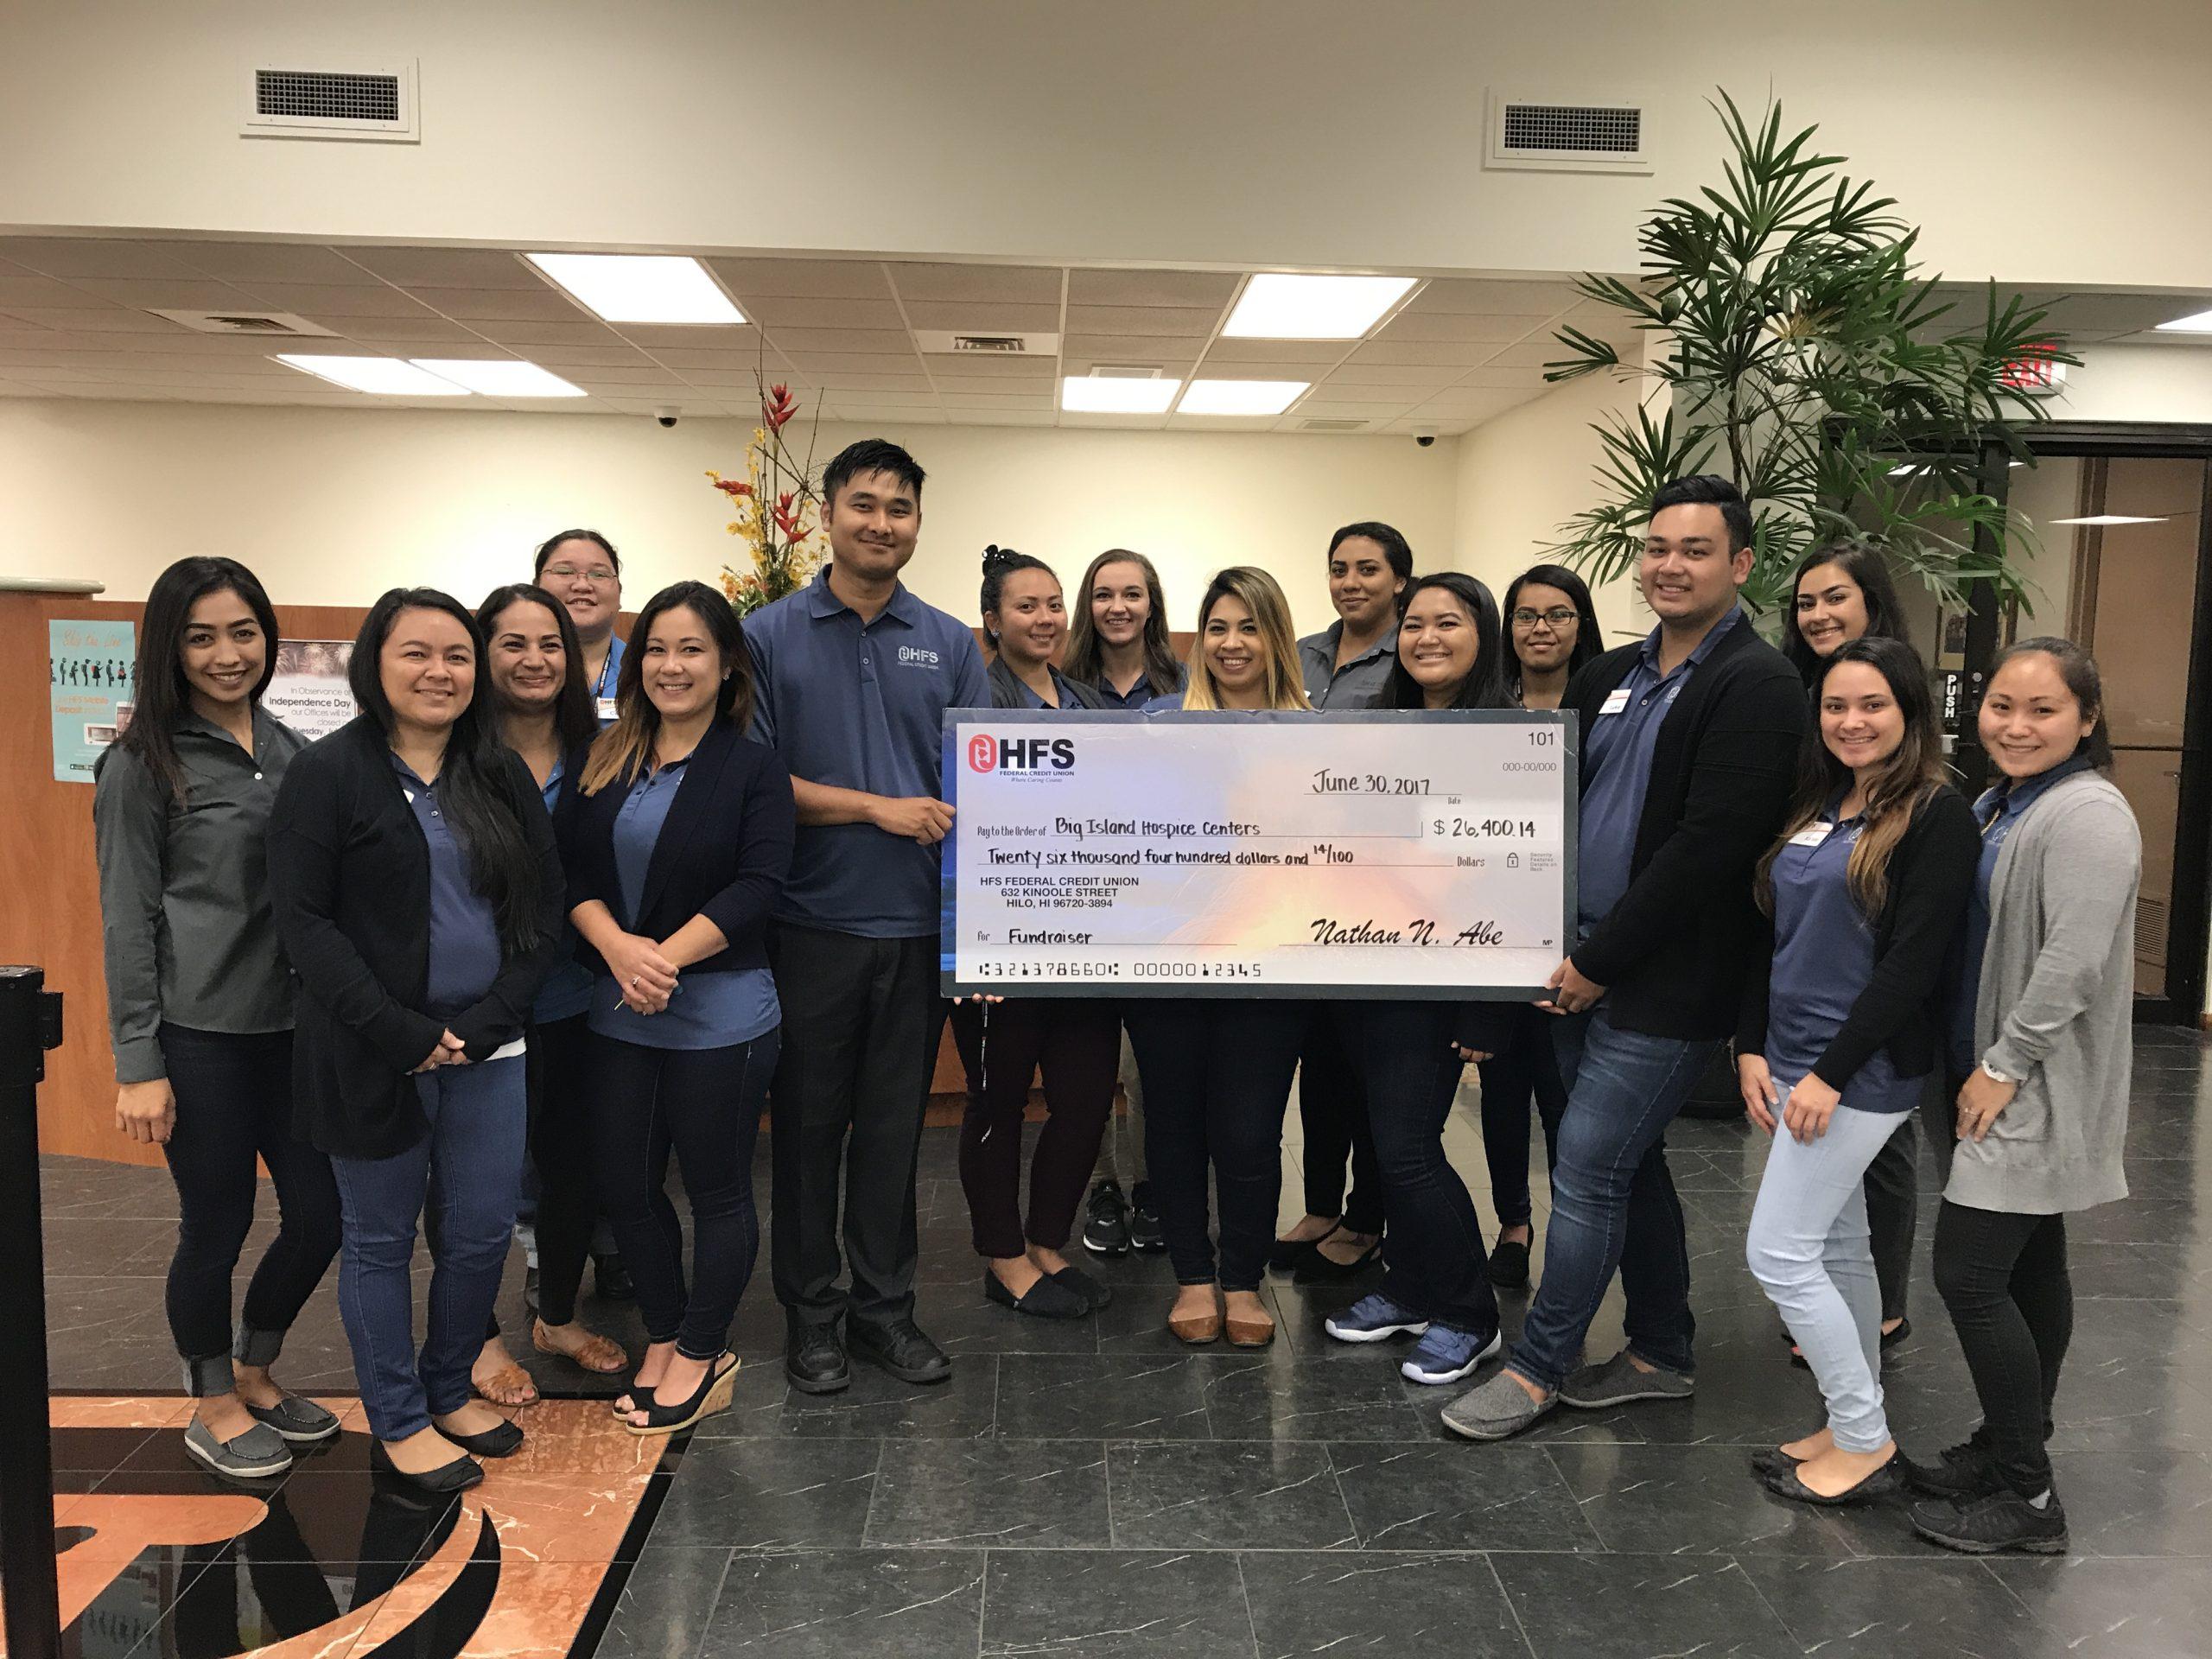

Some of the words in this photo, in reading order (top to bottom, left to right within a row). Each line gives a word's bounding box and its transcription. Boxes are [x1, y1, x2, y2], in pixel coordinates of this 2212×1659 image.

[910, 647, 939, 664] HFS
[270, 696, 332, 708] Independence
[334, 699, 351, 709] Day
[1945, 674, 1957, 718] PUSH
[1529, 732, 1554, 746] 101
[1000, 739, 1075, 769] HFS
[1503, 762, 1557, 772] 000-00/000
[1313, 768, 1360, 793] June
[1395, 779, 1430, 795] 2017
[977, 826, 990, 839] Pay
[991, 827, 1000, 836] to
[1001, 826, 1014, 836] the
[1015, 826, 1037, 836] Order
[1039, 826, 1047, 836] of
[1055, 817, 1084, 842] Big
[1086, 818, 1135, 836] Island
[1142, 818, 1196, 839] Hospice
[1203, 821, 1261, 836] Centers
[1433, 819, 1446, 836] $
[988, 848, 1041, 869] Twenty
[1046, 849, 1067, 865] six
[1071, 849, 1141, 865] thousand
[1145, 849, 1173, 864] four
[1175, 851, 1230, 865] hundred
[1236, 851, 1280, 865] dollars
[1285, 853, 1308, 865] and
[1457, 855, 1485, 868] Dollars
[980, 877, 1002, 886] HFS
[1005, 877, 1056, 886] FEDERAL
[1058, 877, 1101, 886] CREDIT
[1103, 877, 1140, 886] UNION
[1001, 888, 1020, 897] 632
[1022, 888, 1072, 897] KINOOLE
[1075, 888, 1118, 897] STREET
[1007, 899, 1036, 909] HILO,
[1039, 899, 1051, 908] HI
[1053, 899, 1113, 908] 96720-3894
[977, 931, 990, 942] for
[1009, 929, 1094, 944] Fundraiser
[1310, 918, 1402, 945] Nathan
[1408, 918, 1440, 945] N.
[1453, 920, 1503, 946] Abe
